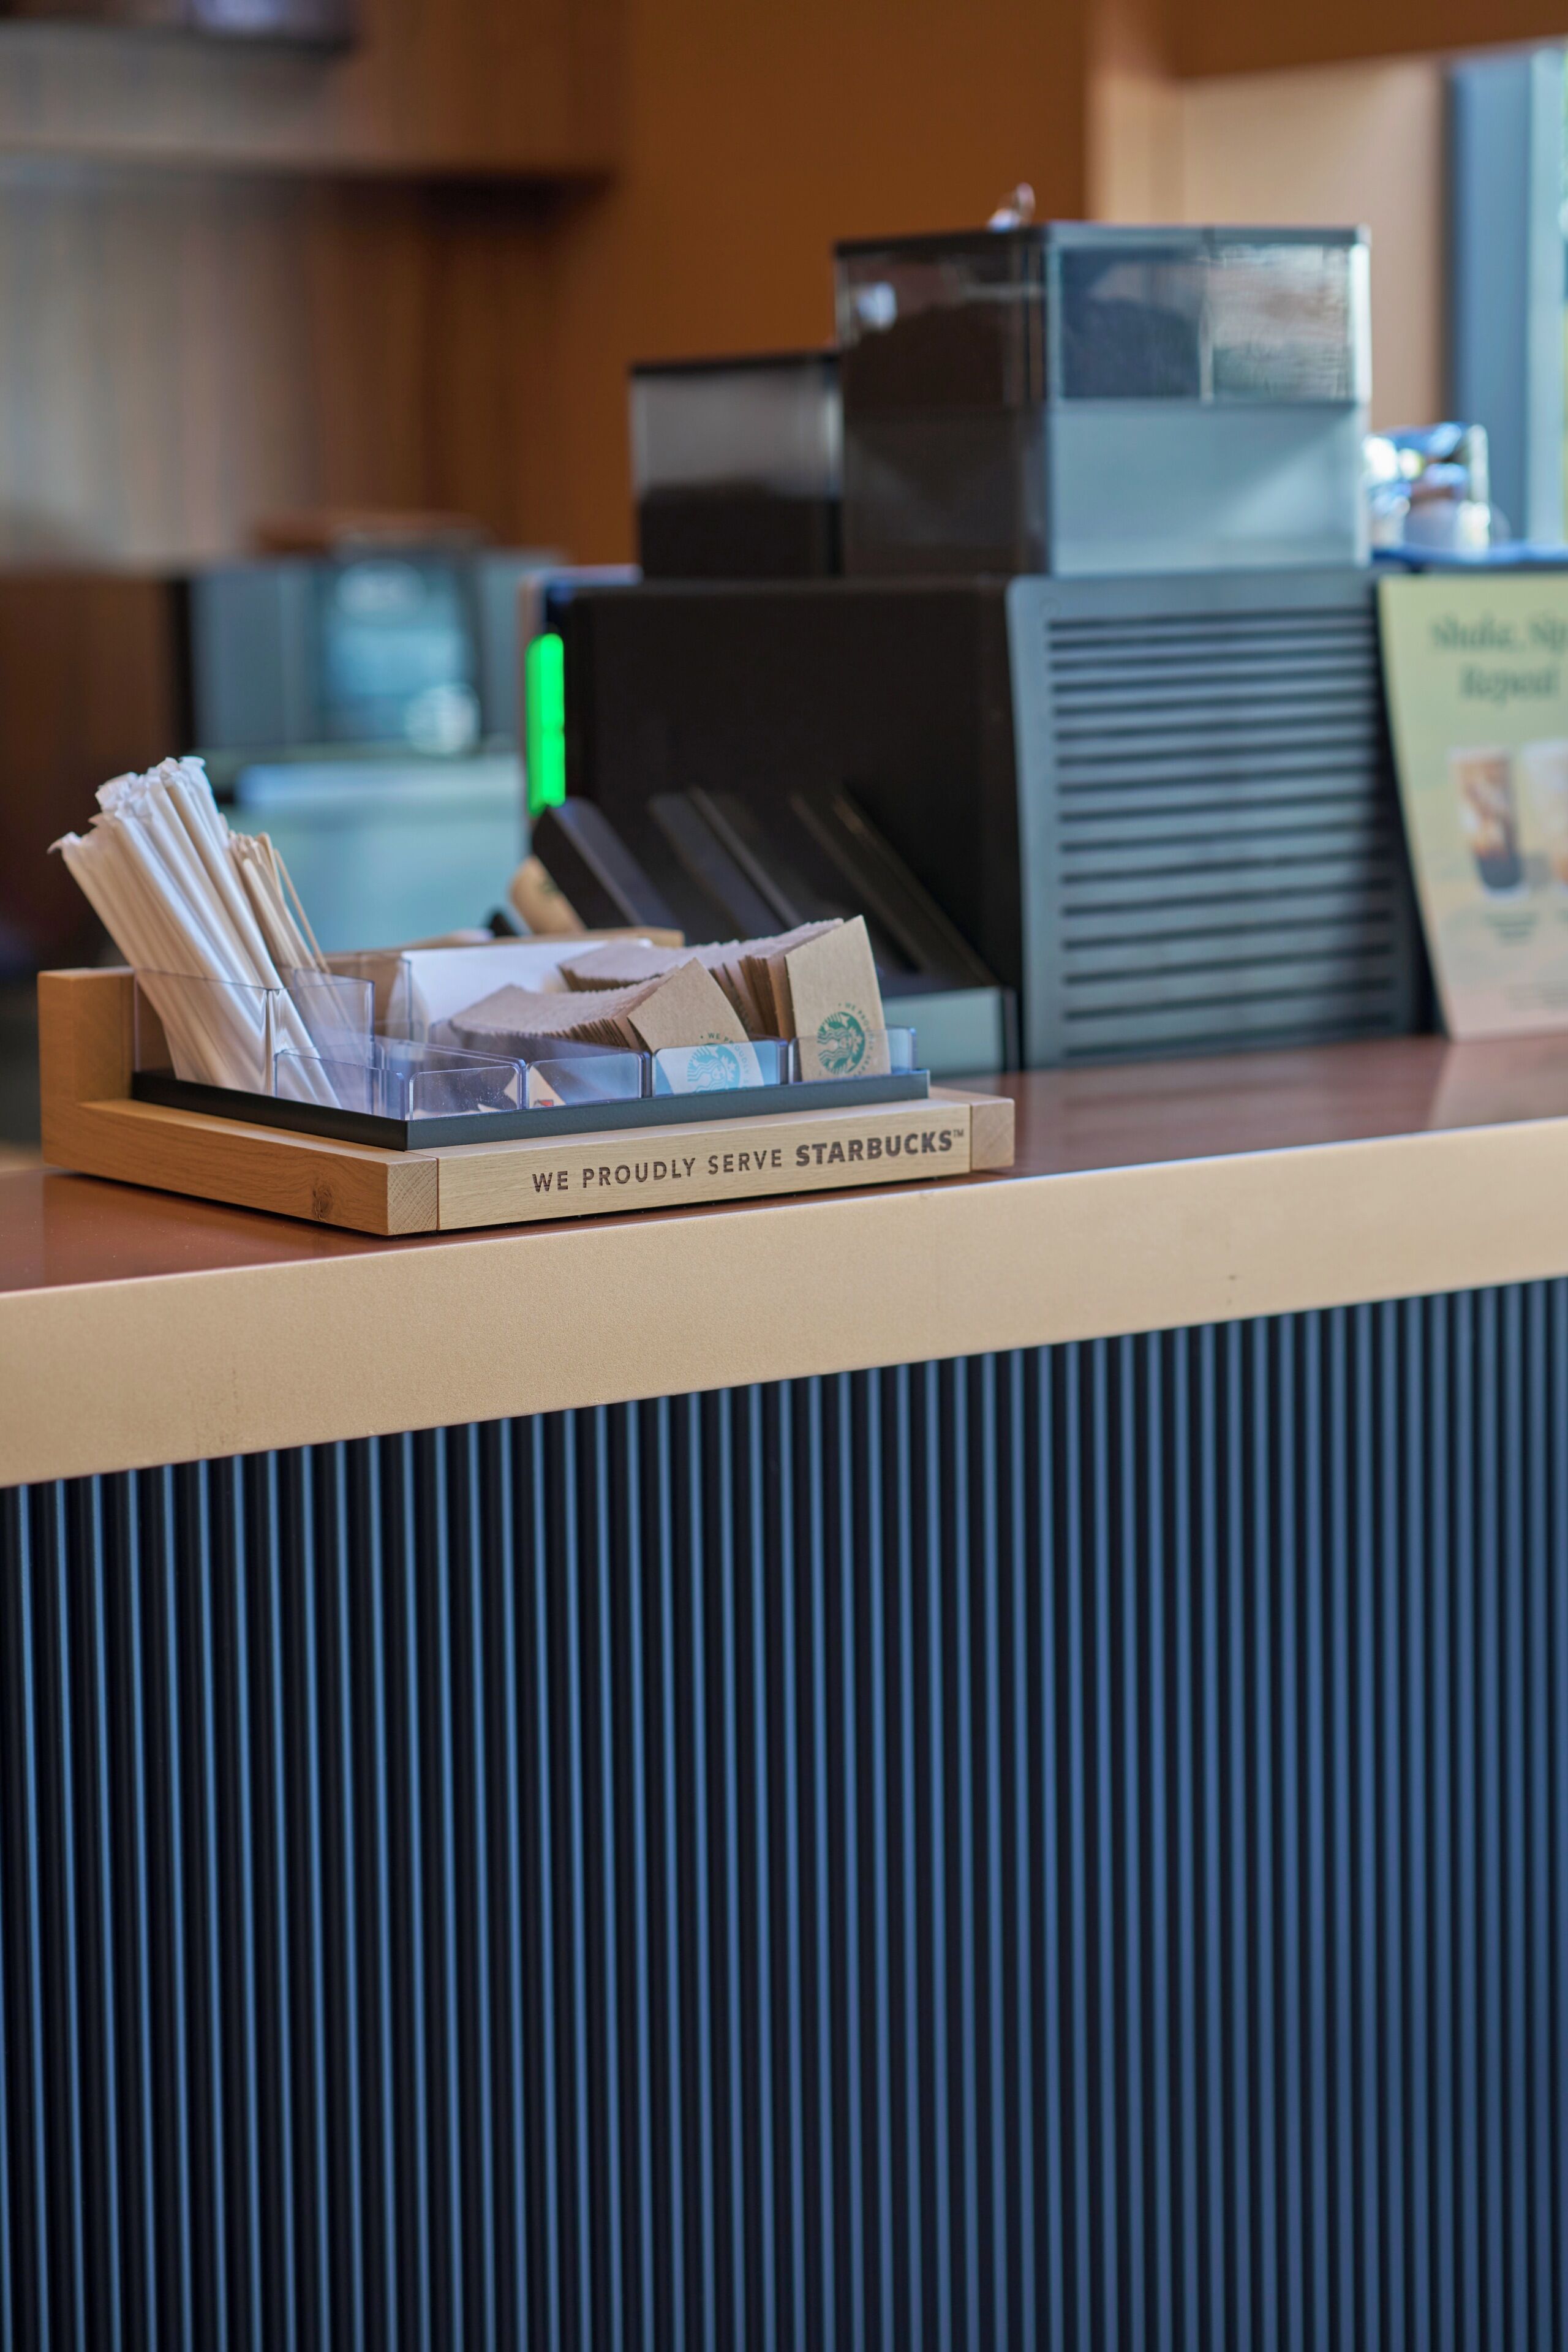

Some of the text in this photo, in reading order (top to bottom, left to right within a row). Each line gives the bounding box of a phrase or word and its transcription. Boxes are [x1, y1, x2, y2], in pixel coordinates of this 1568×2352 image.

[532, 1170, 568, 1193] WE
[582, 1157, 696, 1188] PROUDLY
[707, 1148, 782, 1175] SERVE
